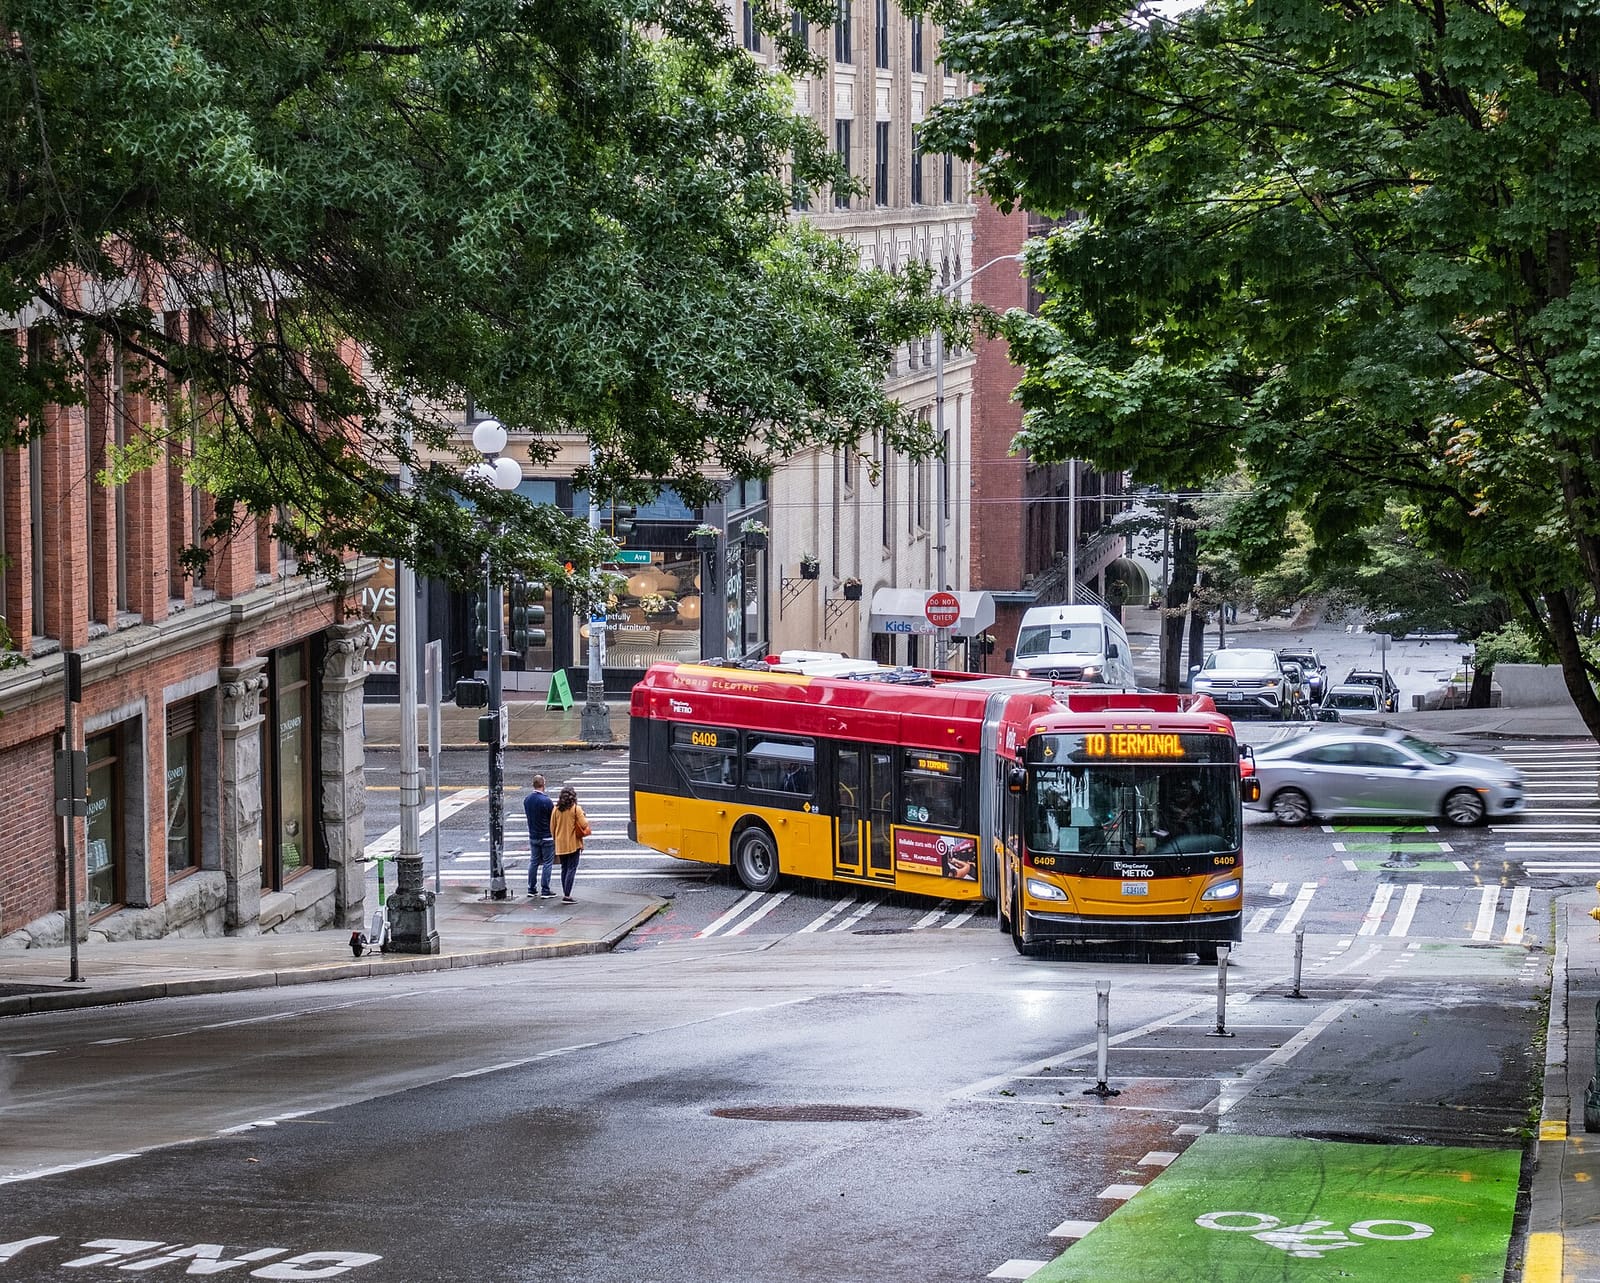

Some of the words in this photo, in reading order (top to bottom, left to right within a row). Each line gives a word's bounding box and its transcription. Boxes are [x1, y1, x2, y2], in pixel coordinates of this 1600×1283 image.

[634, 553, 647, 561] Ave
[619, 623, 651, 631] furniture
[672, 677, 708, 688] HYBRID
[711, 680, 759, 692] ELECTRIC
[692, 731, 717, 747] 6409
[1086, 733, 1106, 757] TO
[1109, 733, 1185, 757] TERMINAL
[1034, 856, 1056, 866] 6409
[1213, 855, 1235, 865] 6409
[1121, 869, 1154, 877] METRO
